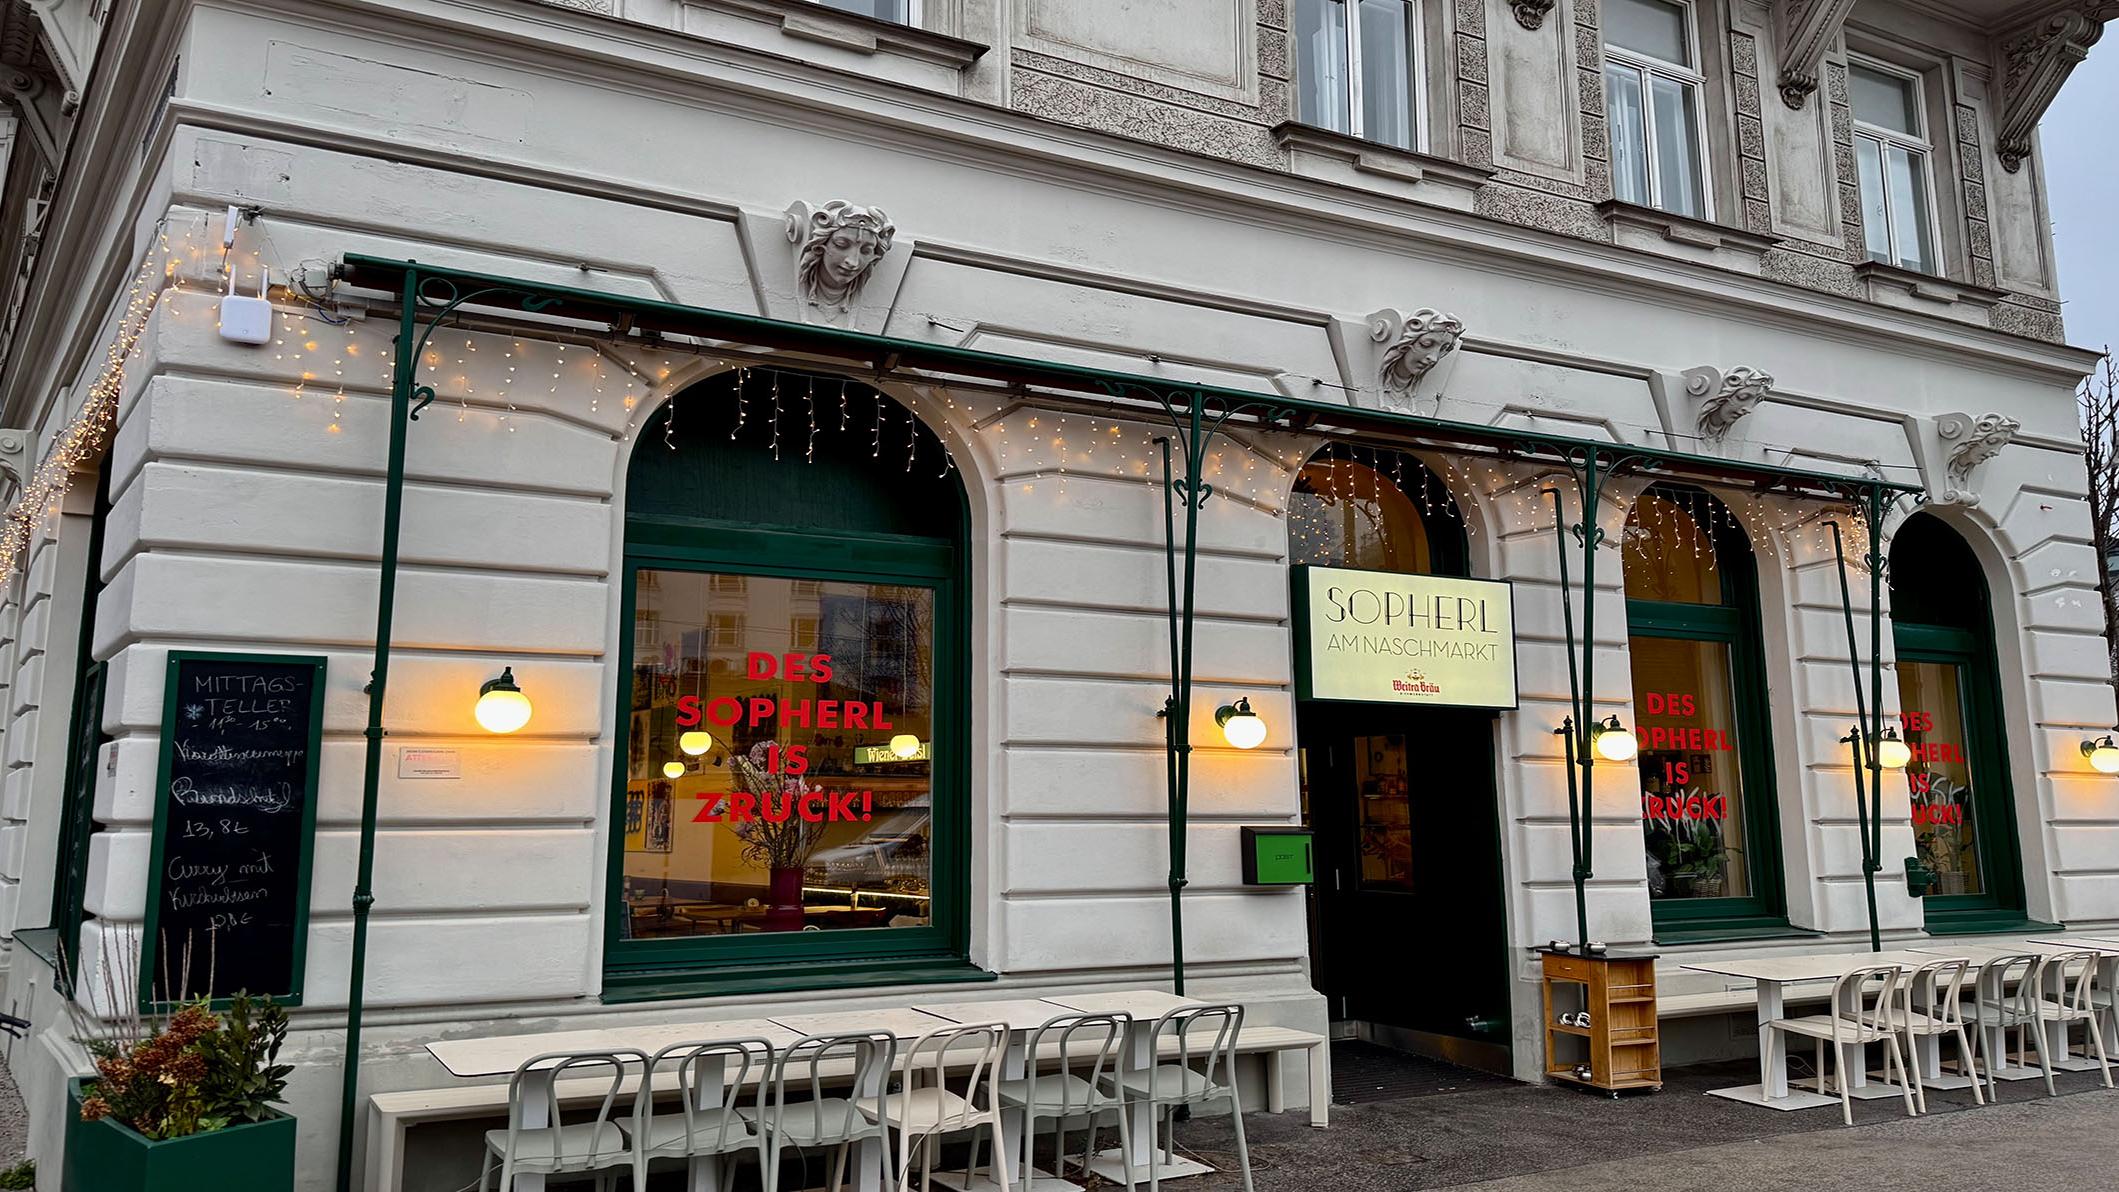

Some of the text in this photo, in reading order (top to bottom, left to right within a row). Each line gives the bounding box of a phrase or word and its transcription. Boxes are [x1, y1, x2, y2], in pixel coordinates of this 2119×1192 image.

[1325, 586, 1499, 634] SOPHERL
[1327, 634, 1499, 661] AM NASCHMARKT
[747, 652, 833, 683] DES
[195, 676, 304, 694] MITTAGS-
[204, 699, 294, 716] TELLER
[676, 695, 892, 730] SOPHERL
[1647, 692, 1696, 716] DES
[1901, 711, 1934, 732] DES
[1636, 726, 1733, 752] OPHERL
[767, 744, 809, 775] IS
[1910, 742, 1964, 764] HERL
[1665, 762, 1690, 785] IS
[1910, 772, 1930, 793] IS
[691, 791, 873, 824] ZRUCK!
[1911, 803, 1963, 825] UCK!
